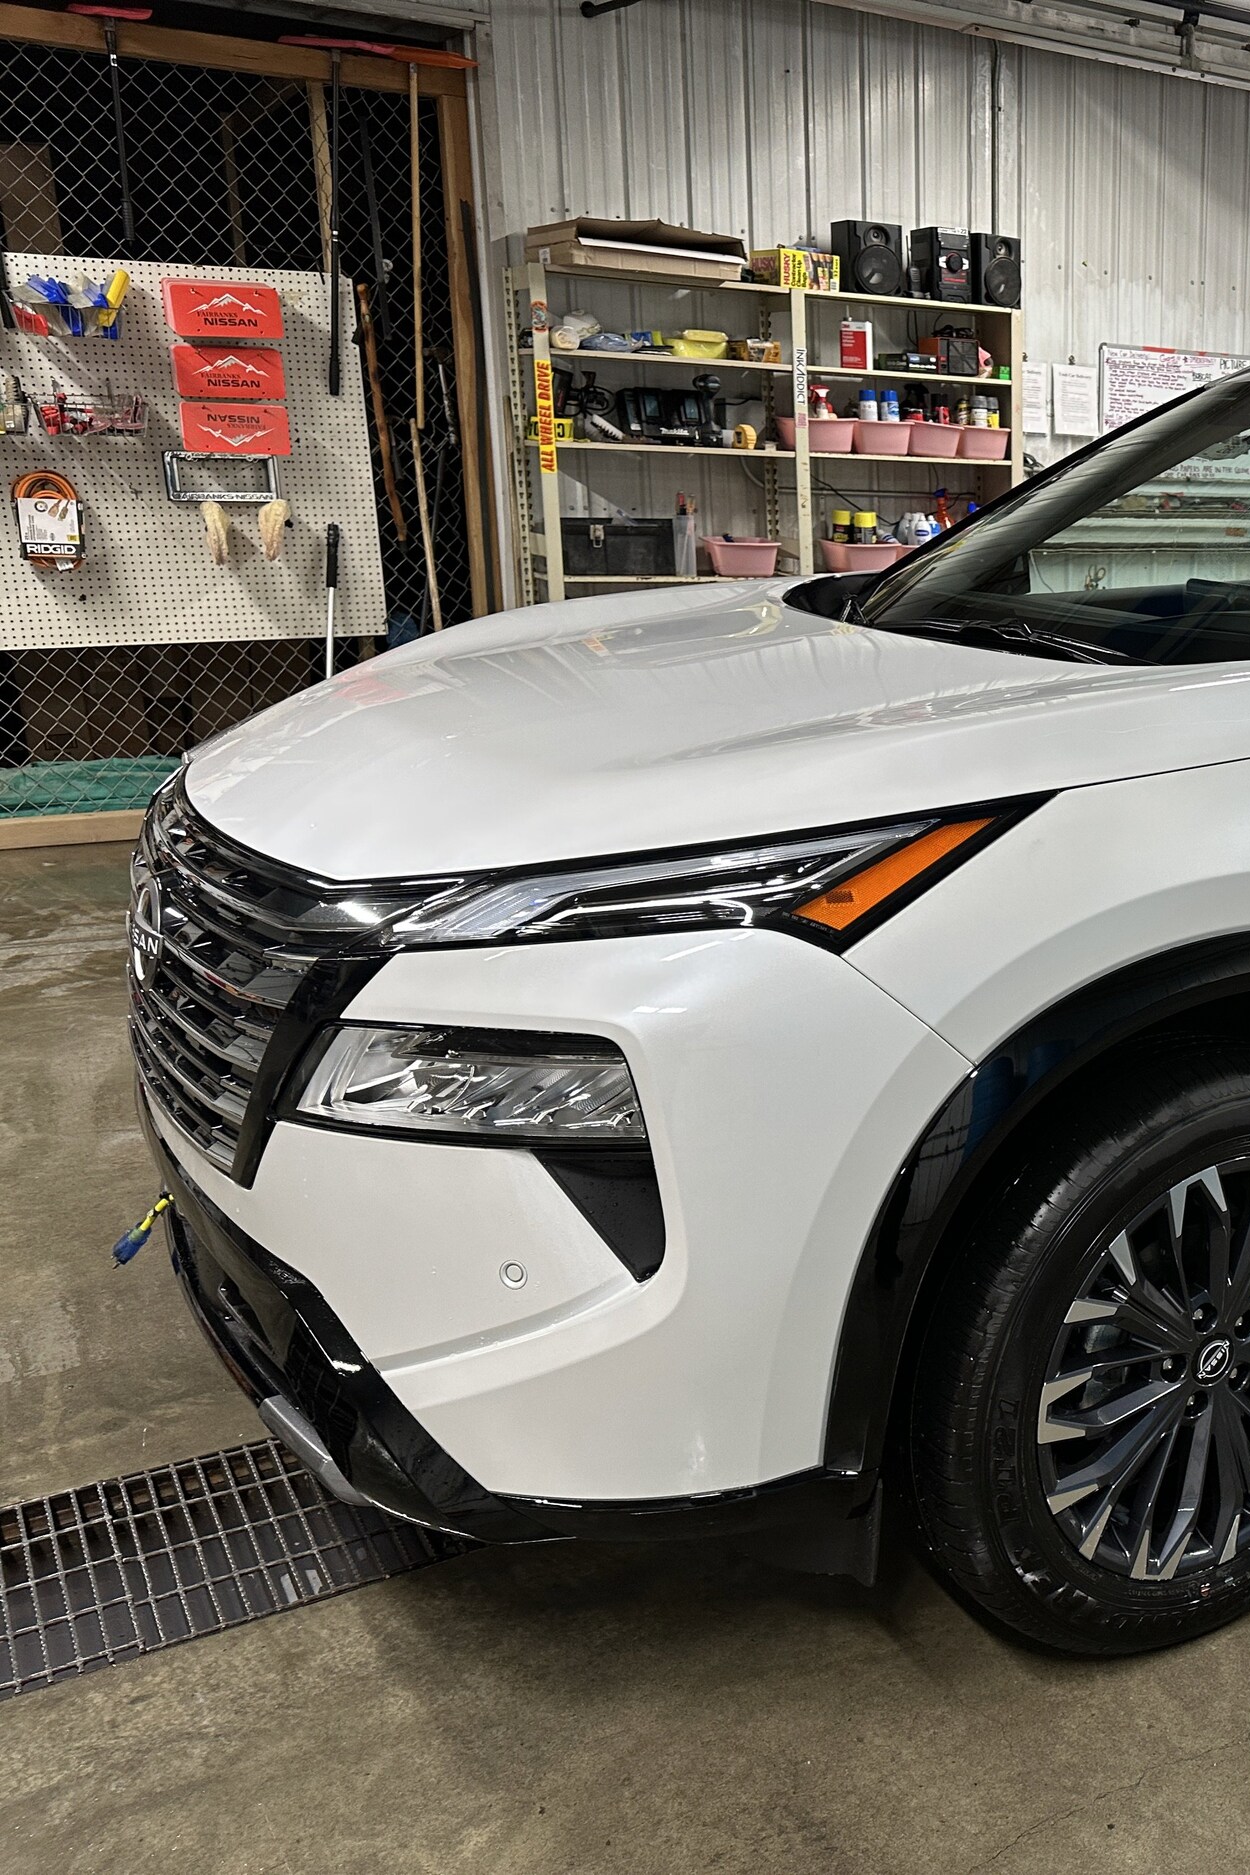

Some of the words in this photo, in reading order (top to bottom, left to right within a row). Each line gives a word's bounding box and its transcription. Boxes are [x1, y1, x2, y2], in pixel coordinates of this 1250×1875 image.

[204, 318, 258, 327] NISSAN
[207, 379, 260, 388] NISSAN
[536, 361, 552, 402] DRIVE
[207, 414, 260, 423] NISSAN
[539, 404, 554, 448] WHEEL
[541, 450, 555, 472] ALL
[26, 544, 76, 554] RIDGID
[1198, 1339, 1230, 1380] NISSAN
